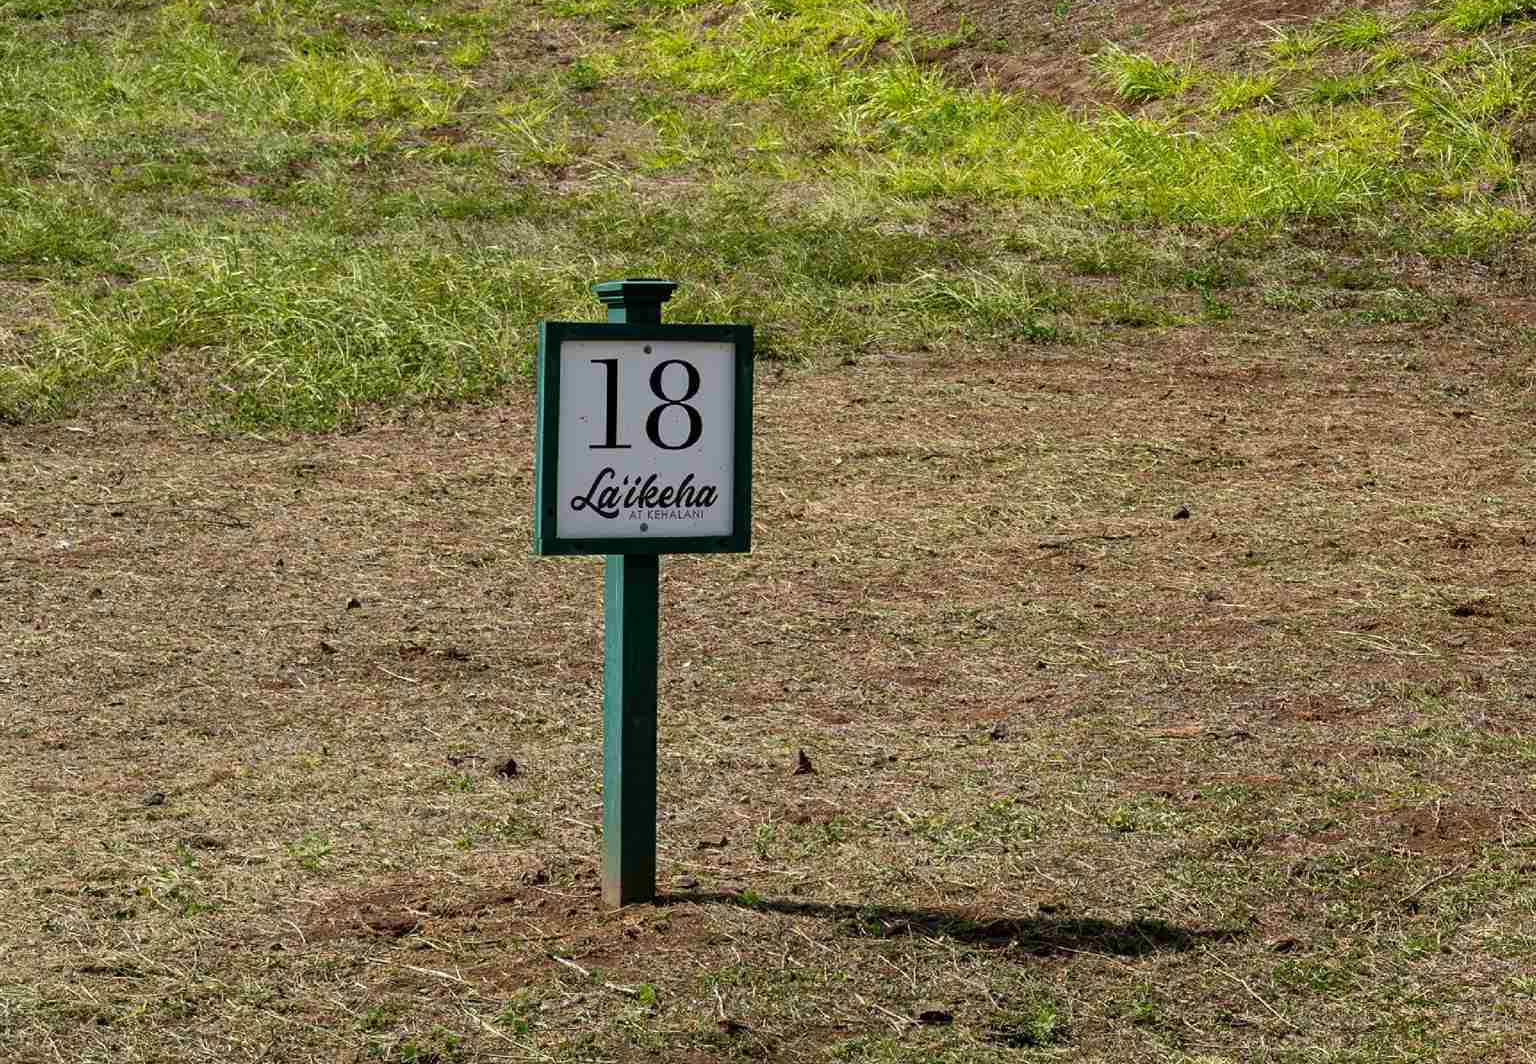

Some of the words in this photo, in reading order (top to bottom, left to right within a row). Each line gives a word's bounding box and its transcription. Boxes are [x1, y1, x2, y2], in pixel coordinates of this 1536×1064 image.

[588, 358, 703, 451] 18
[628, 509, 644, 521] AT
[647, 509, 705, 521] KEHALANI
